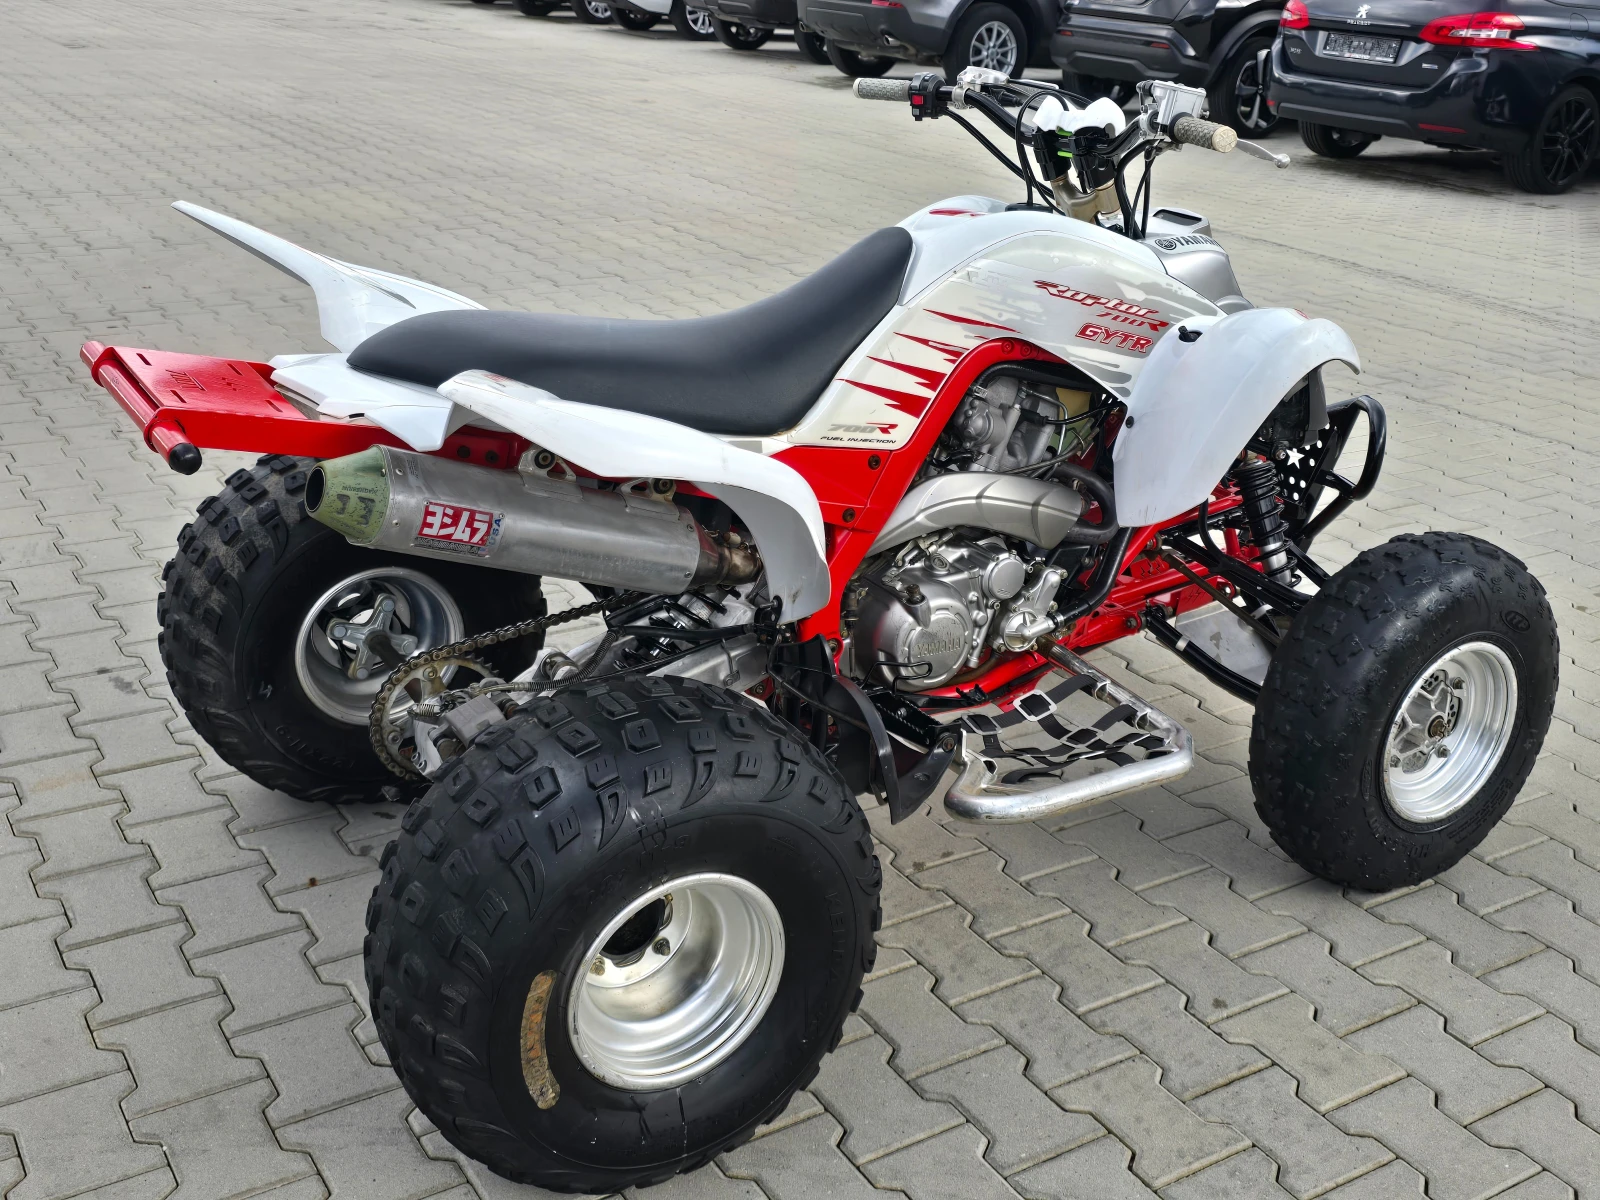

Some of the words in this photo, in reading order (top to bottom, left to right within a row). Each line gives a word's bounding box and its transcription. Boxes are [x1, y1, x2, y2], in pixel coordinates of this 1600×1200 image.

[1075, 323, 1154, 354] GYTR
[827, 422, 899, 435] 700R
[422, 504, 490, 544] ヨシムラ
[488, 518, 502, 546] USA
[917, 637, 961, 658] YAMAHA
